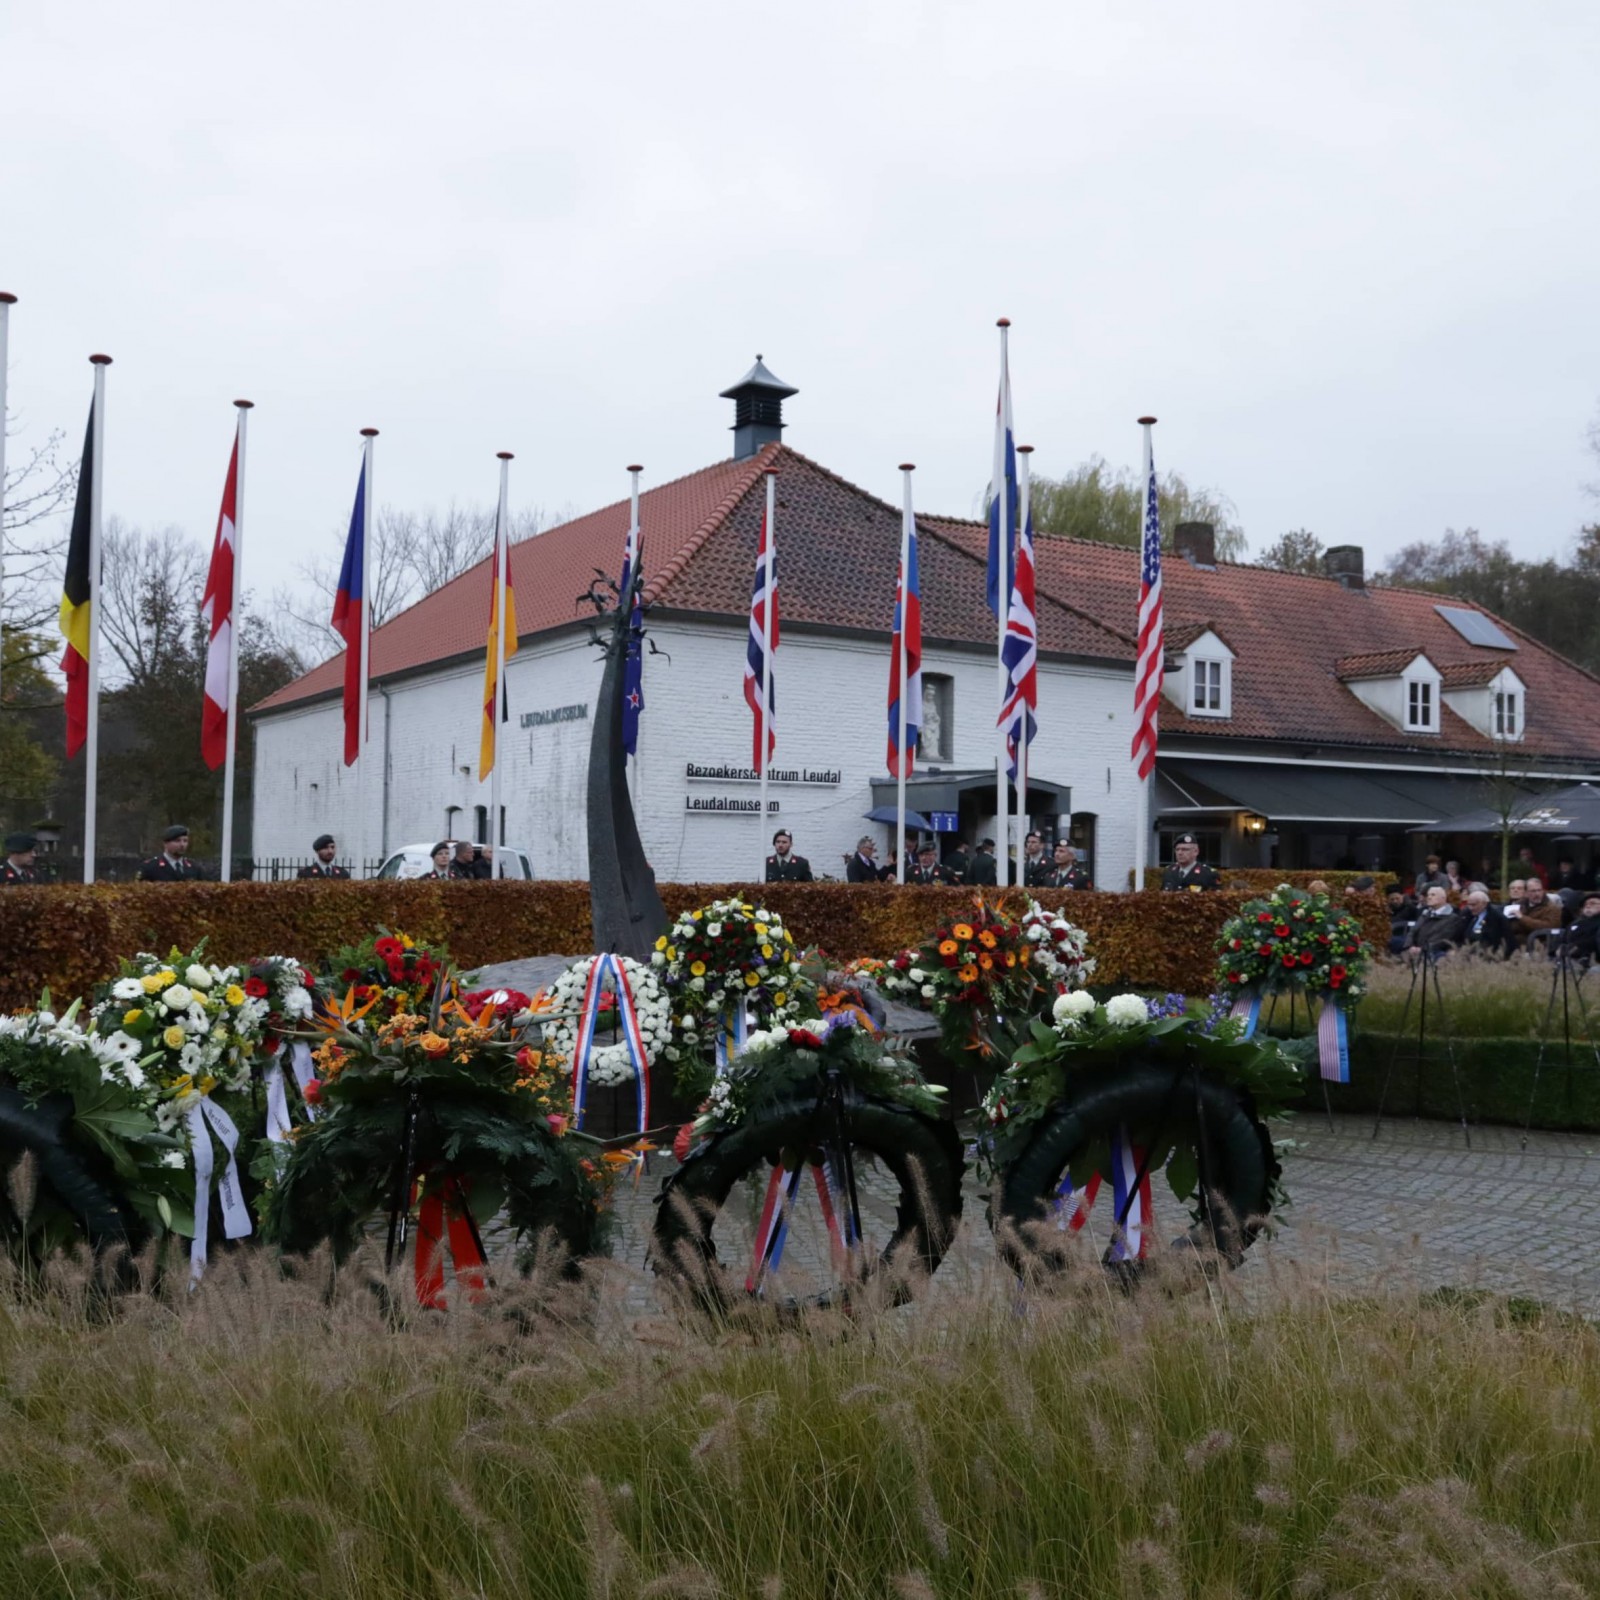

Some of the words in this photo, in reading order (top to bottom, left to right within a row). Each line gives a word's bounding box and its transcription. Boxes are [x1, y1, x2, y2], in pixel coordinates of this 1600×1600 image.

[520, 703, 588, 728] LEUDALMUSEUM
[803, 768, 841, 784] Leudal
[686, 795, 780, 812] Leudalmusem
